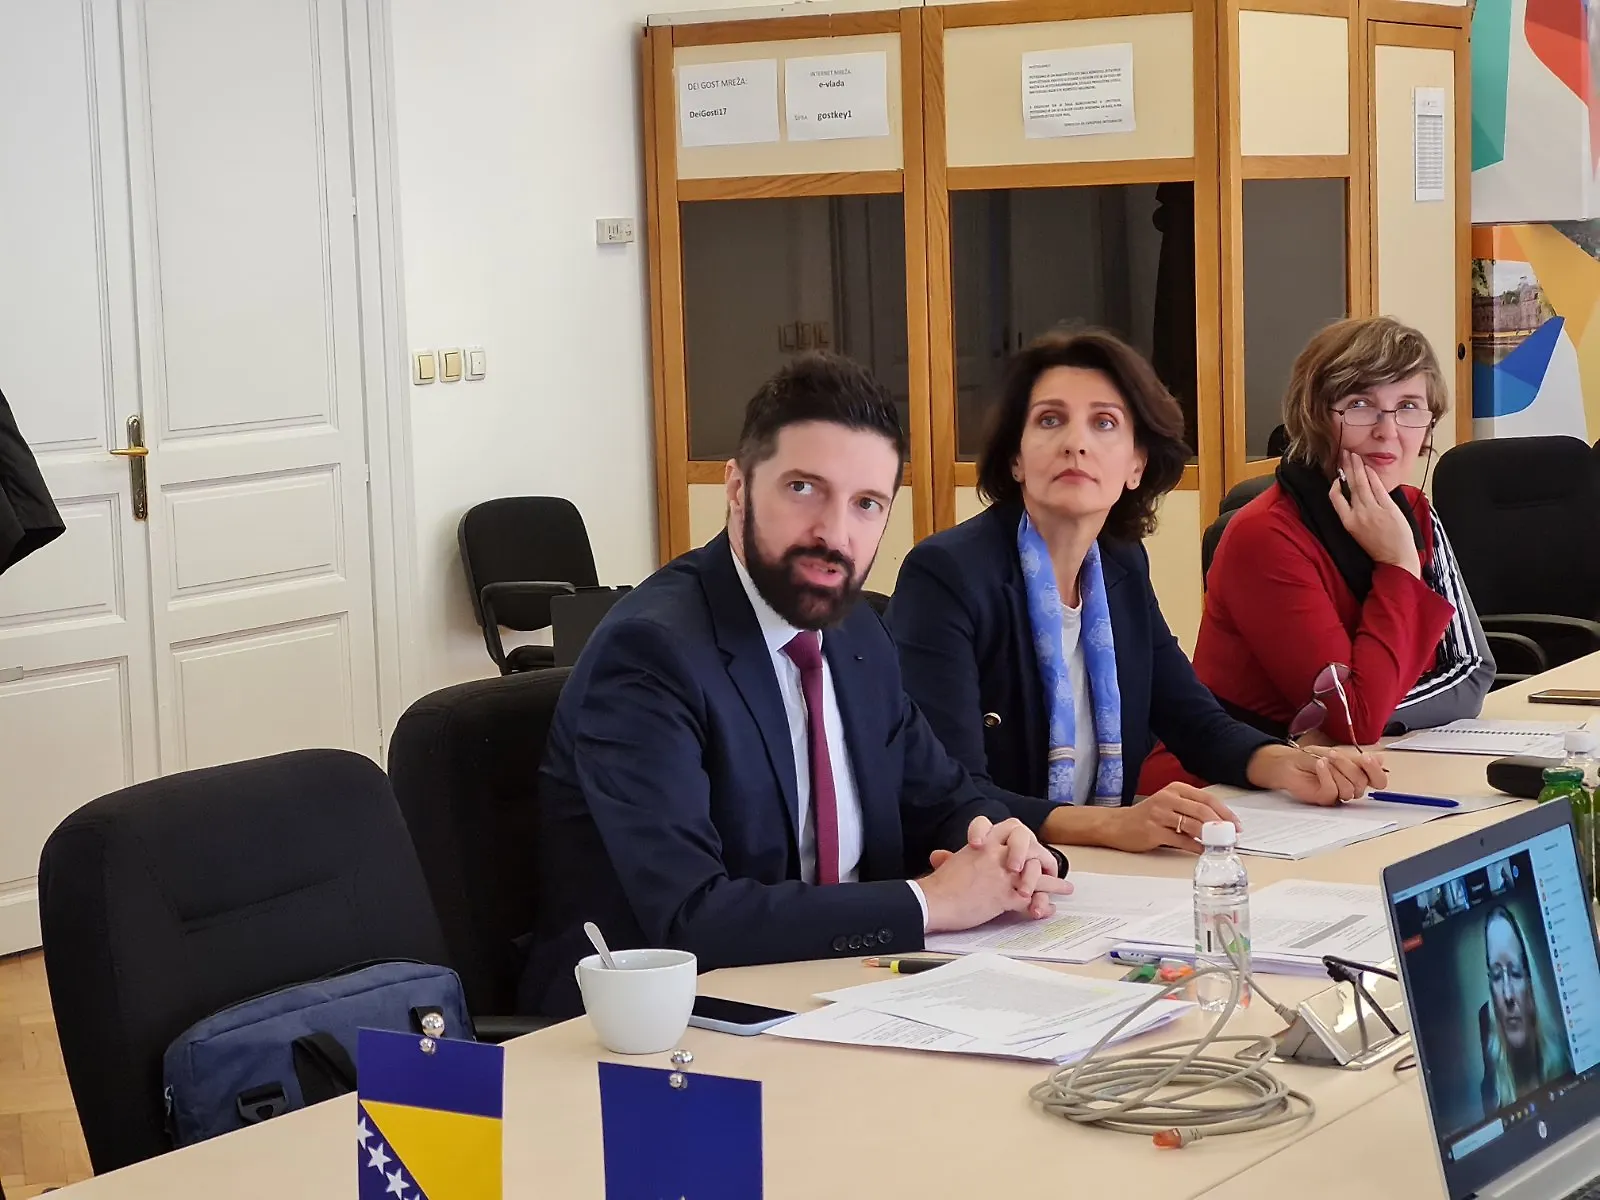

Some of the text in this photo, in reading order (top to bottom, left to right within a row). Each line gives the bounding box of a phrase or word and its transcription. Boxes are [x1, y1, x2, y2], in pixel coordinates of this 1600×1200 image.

[688, 82, 700, 91] DEI
[701, 80, 719, 90] GOST
[818, 79, 845, 88] e-vlada
[689, 107, 727, 118] DeiGosti17
[817, 110, 852, 121] gostkey1
